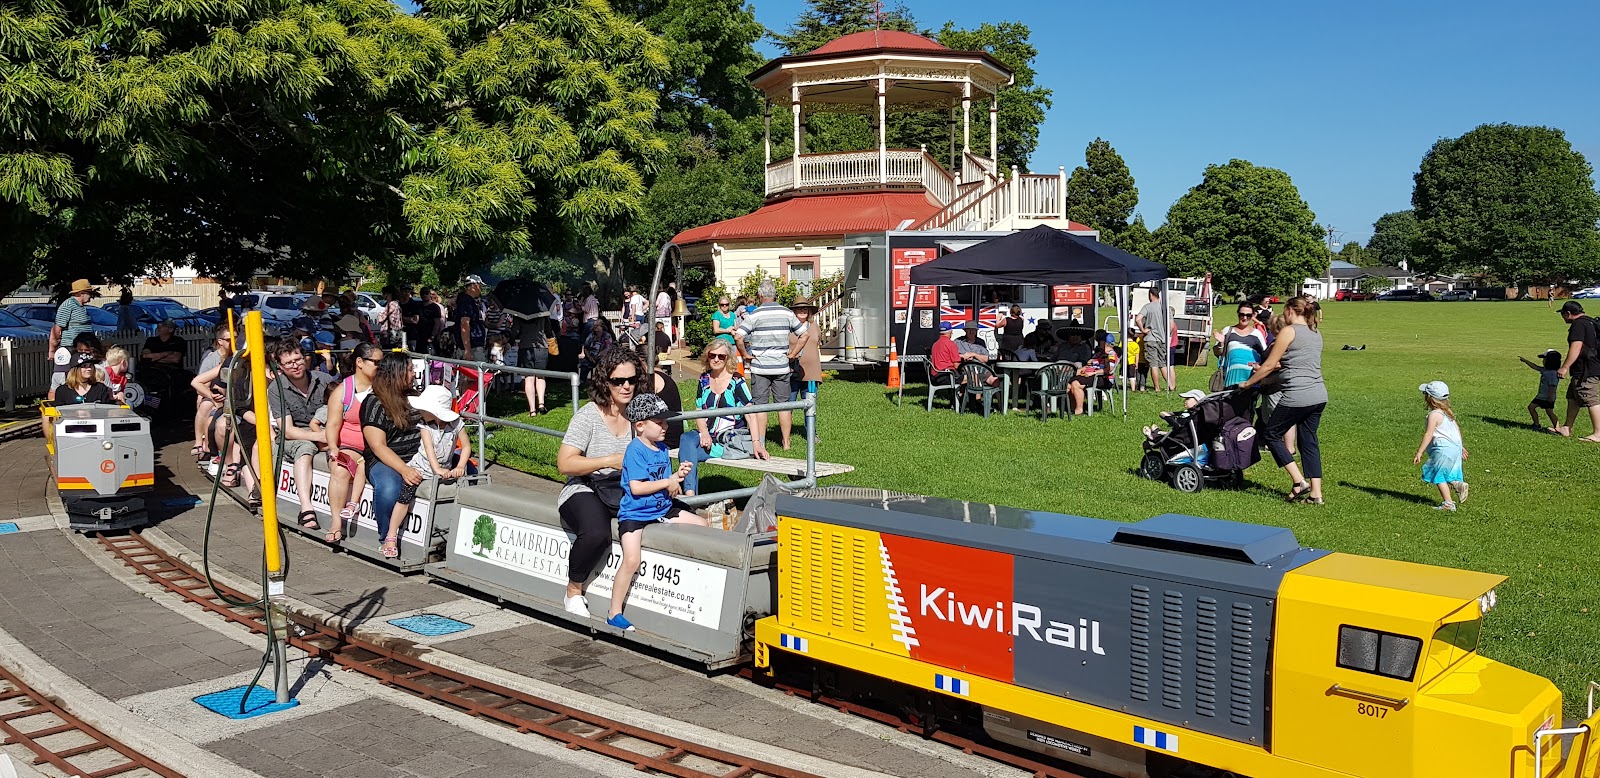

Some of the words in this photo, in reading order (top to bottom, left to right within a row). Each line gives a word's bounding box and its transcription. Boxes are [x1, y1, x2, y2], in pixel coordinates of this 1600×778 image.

[500, 526, 570, 560] CAMBRIDG
[496, 547, 525, 565] REAL
[533, 556, 569, 577] ESTAT
[606, 552, 621, 570] 07
[652, 564, 681, 586] 1945
[595, 570, 695, 604] www.cdgerealestate.co.nz
[919, 583, 1106, 656] KiwiRail
[1357, 702, 1388, 719] 8017
